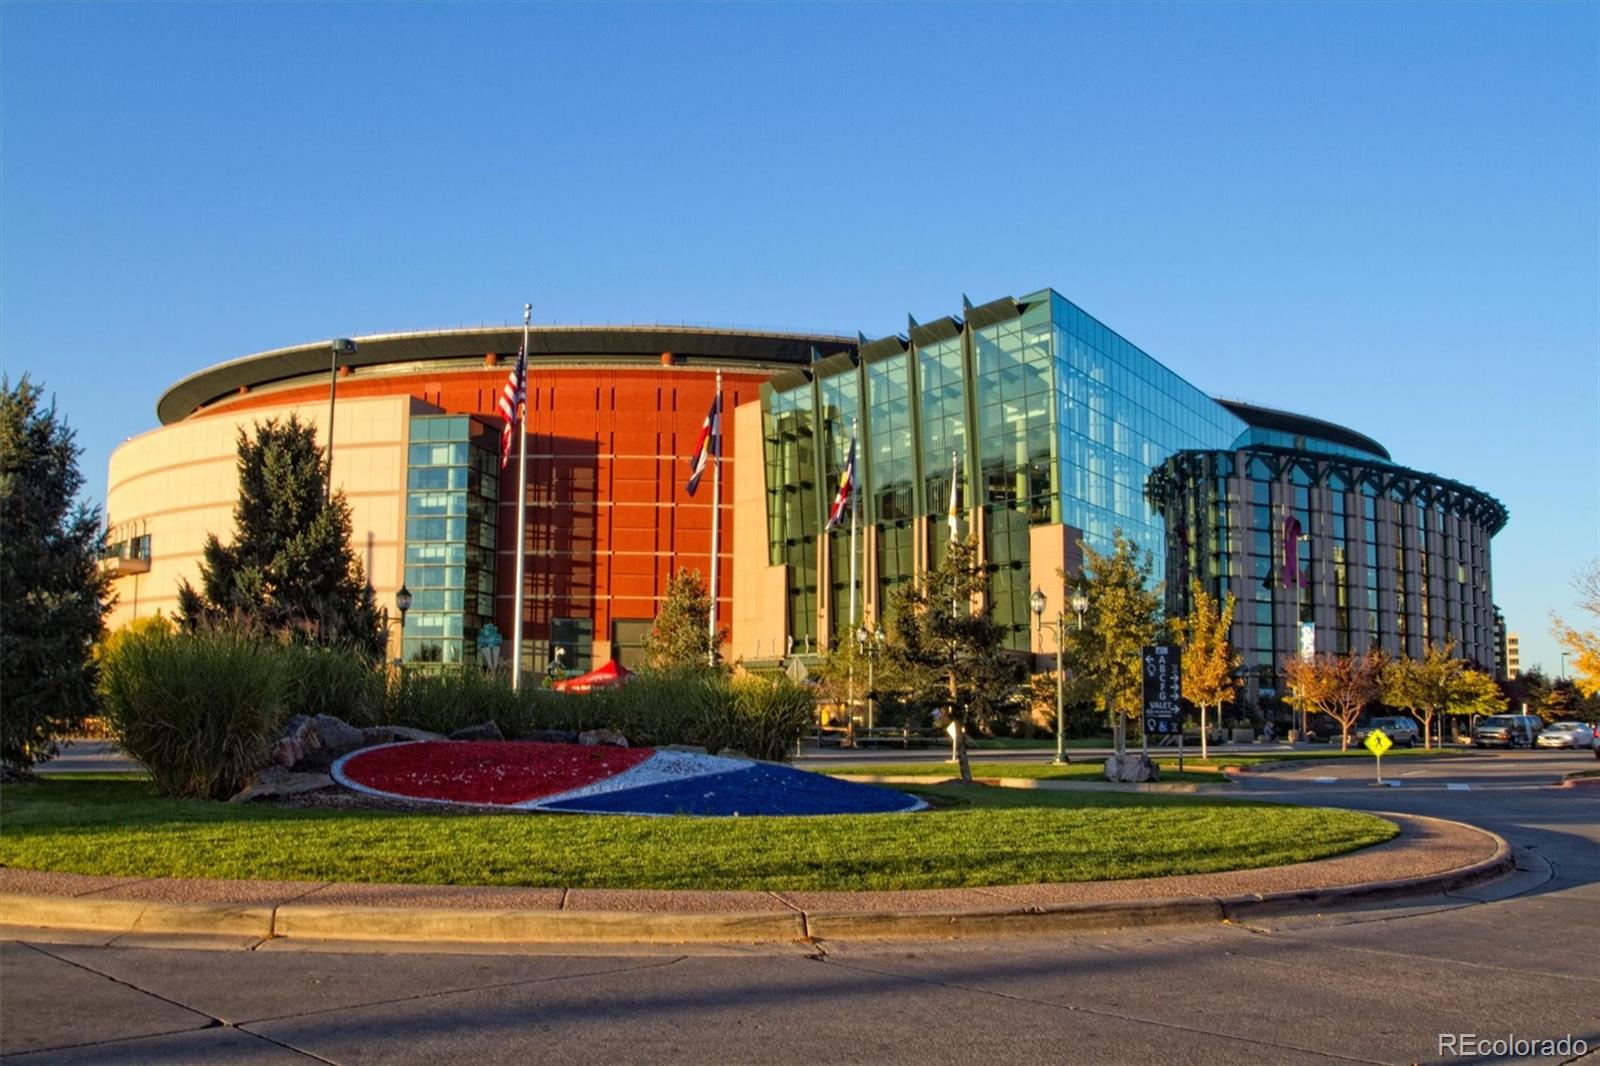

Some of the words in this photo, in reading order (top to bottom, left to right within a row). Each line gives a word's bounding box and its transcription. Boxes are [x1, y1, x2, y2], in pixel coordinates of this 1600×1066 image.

[1159, 656, 1166, 664] A
[1159, 665, 1166, 673] B
[1159, 674, 1166, 682] C
[1149, 701, 1172, 709] VALET
